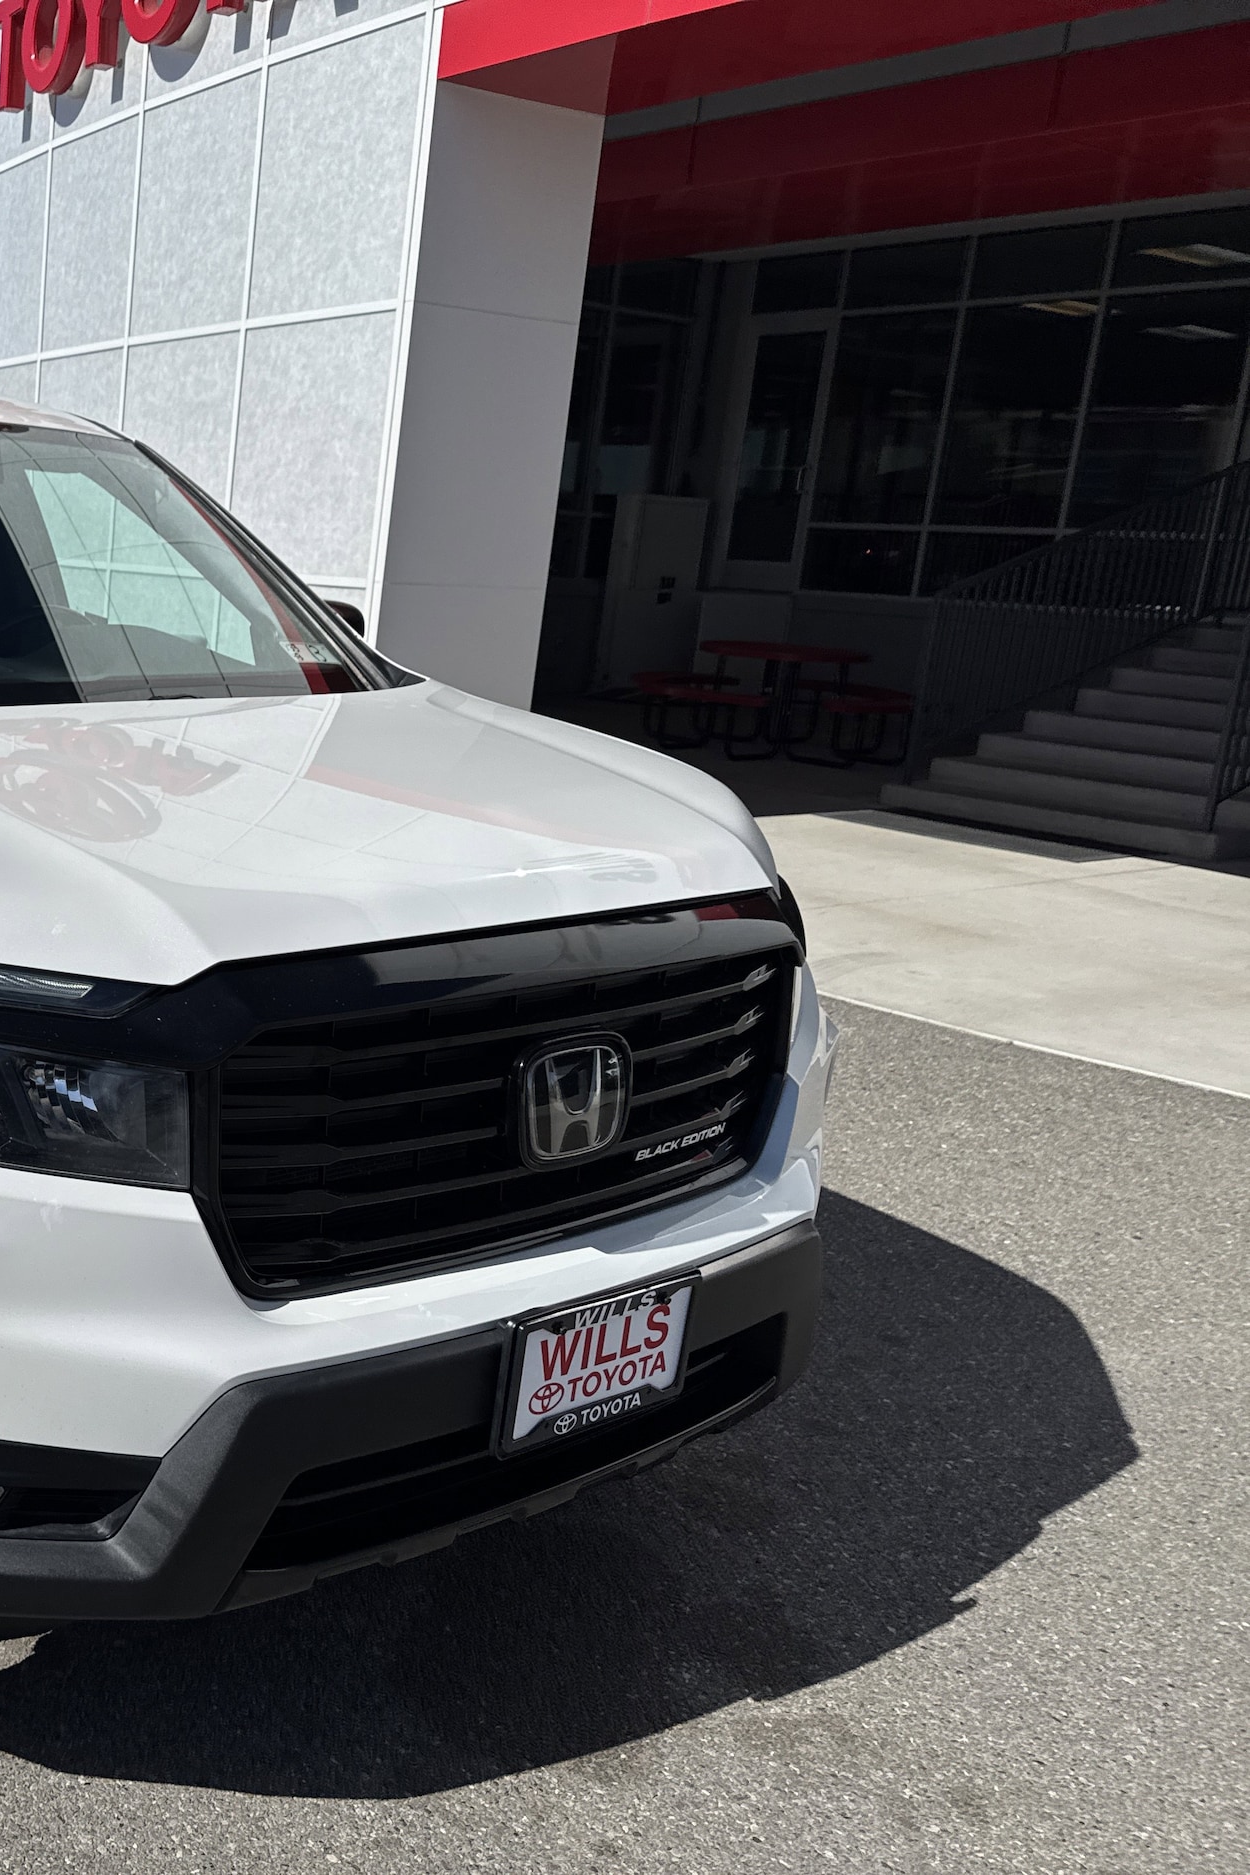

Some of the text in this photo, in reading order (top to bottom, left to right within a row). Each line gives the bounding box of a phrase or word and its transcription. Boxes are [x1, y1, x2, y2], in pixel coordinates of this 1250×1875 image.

[634, 1122, 726, 1162] BLACK EDITION
[540, 1303, 671, 1381] WILLS
[567, 1350, 666, 1402] TOYOTA
[580, 1392, 641, 1425] TOYOTA
